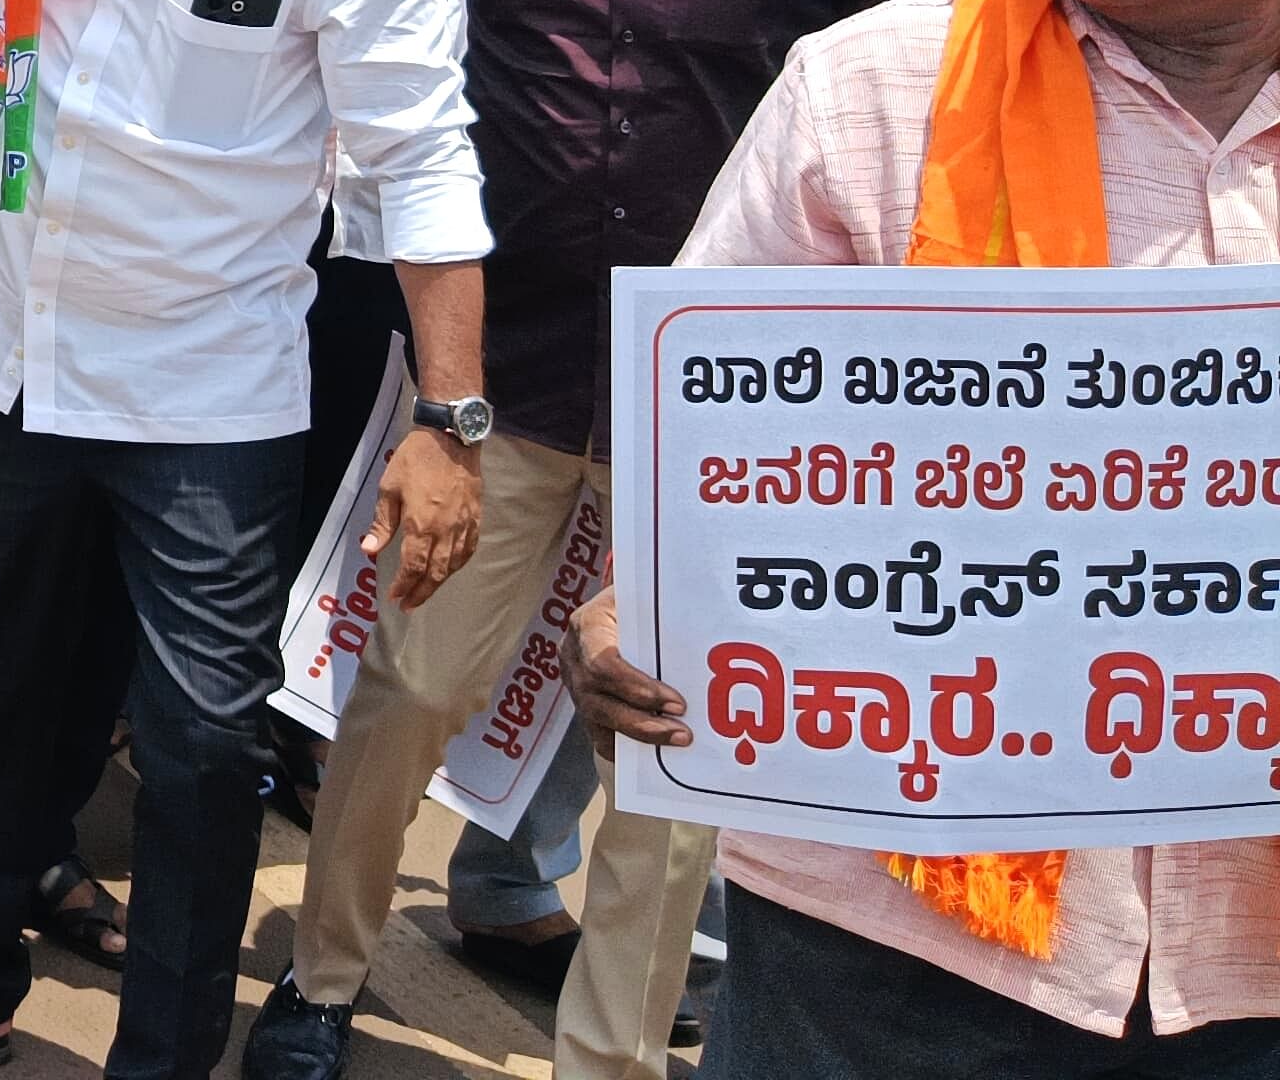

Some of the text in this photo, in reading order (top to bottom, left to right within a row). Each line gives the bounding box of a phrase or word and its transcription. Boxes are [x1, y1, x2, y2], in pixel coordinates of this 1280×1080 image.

[681, 342, 1280, 409] ಖಾಲಿ ಖಜಾನೆ ತುಂಬಿಸಿ
[698, 442, 896, 507] ಜನರಿಗೆ
[914, 444, 1027, 511] ಬೆಲೆ
[1044, 445, 1188, 512] ಏರಿಕೆ
[736, 540, 1060, 636] ಕಾಂಗ್ರೆಸ್
[483, 633, 559, 759] ಜೇಬಿಗೆ
[707, 642, 1052, 801] ಧಿಕ್ಕಾರ..
